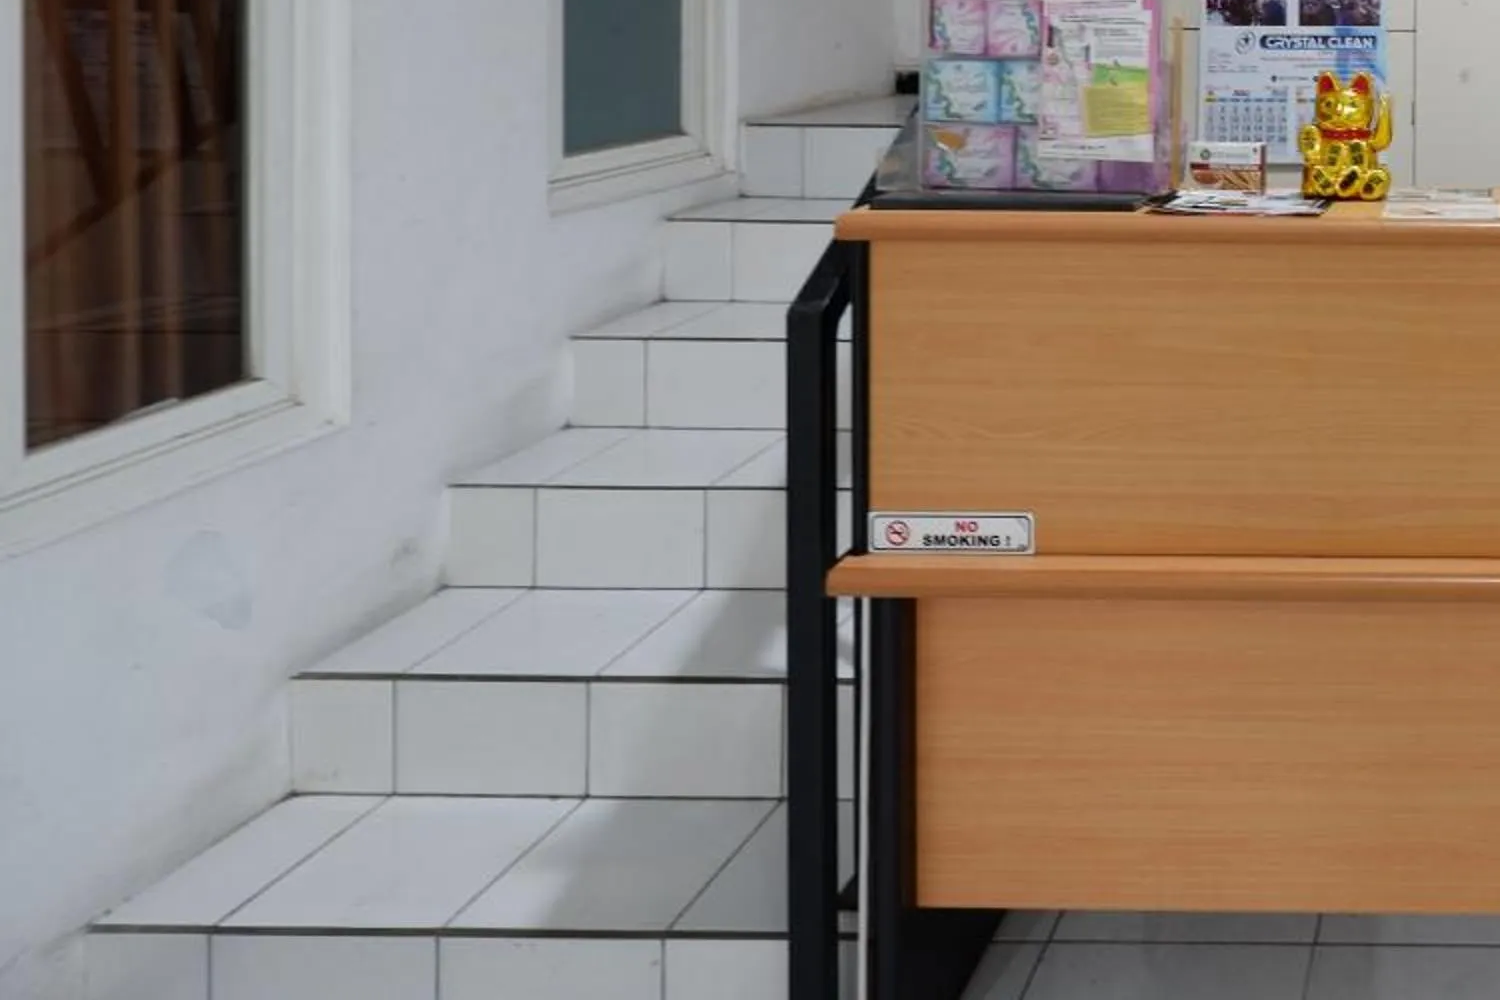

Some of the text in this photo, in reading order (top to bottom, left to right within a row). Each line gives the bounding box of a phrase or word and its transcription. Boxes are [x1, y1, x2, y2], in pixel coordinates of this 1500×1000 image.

[1265, 36, 1373, 49] CRYSTAL CLEAN
[955, 521, 979, 533] NO
[922, 535, 1001, 547] SMOKING
